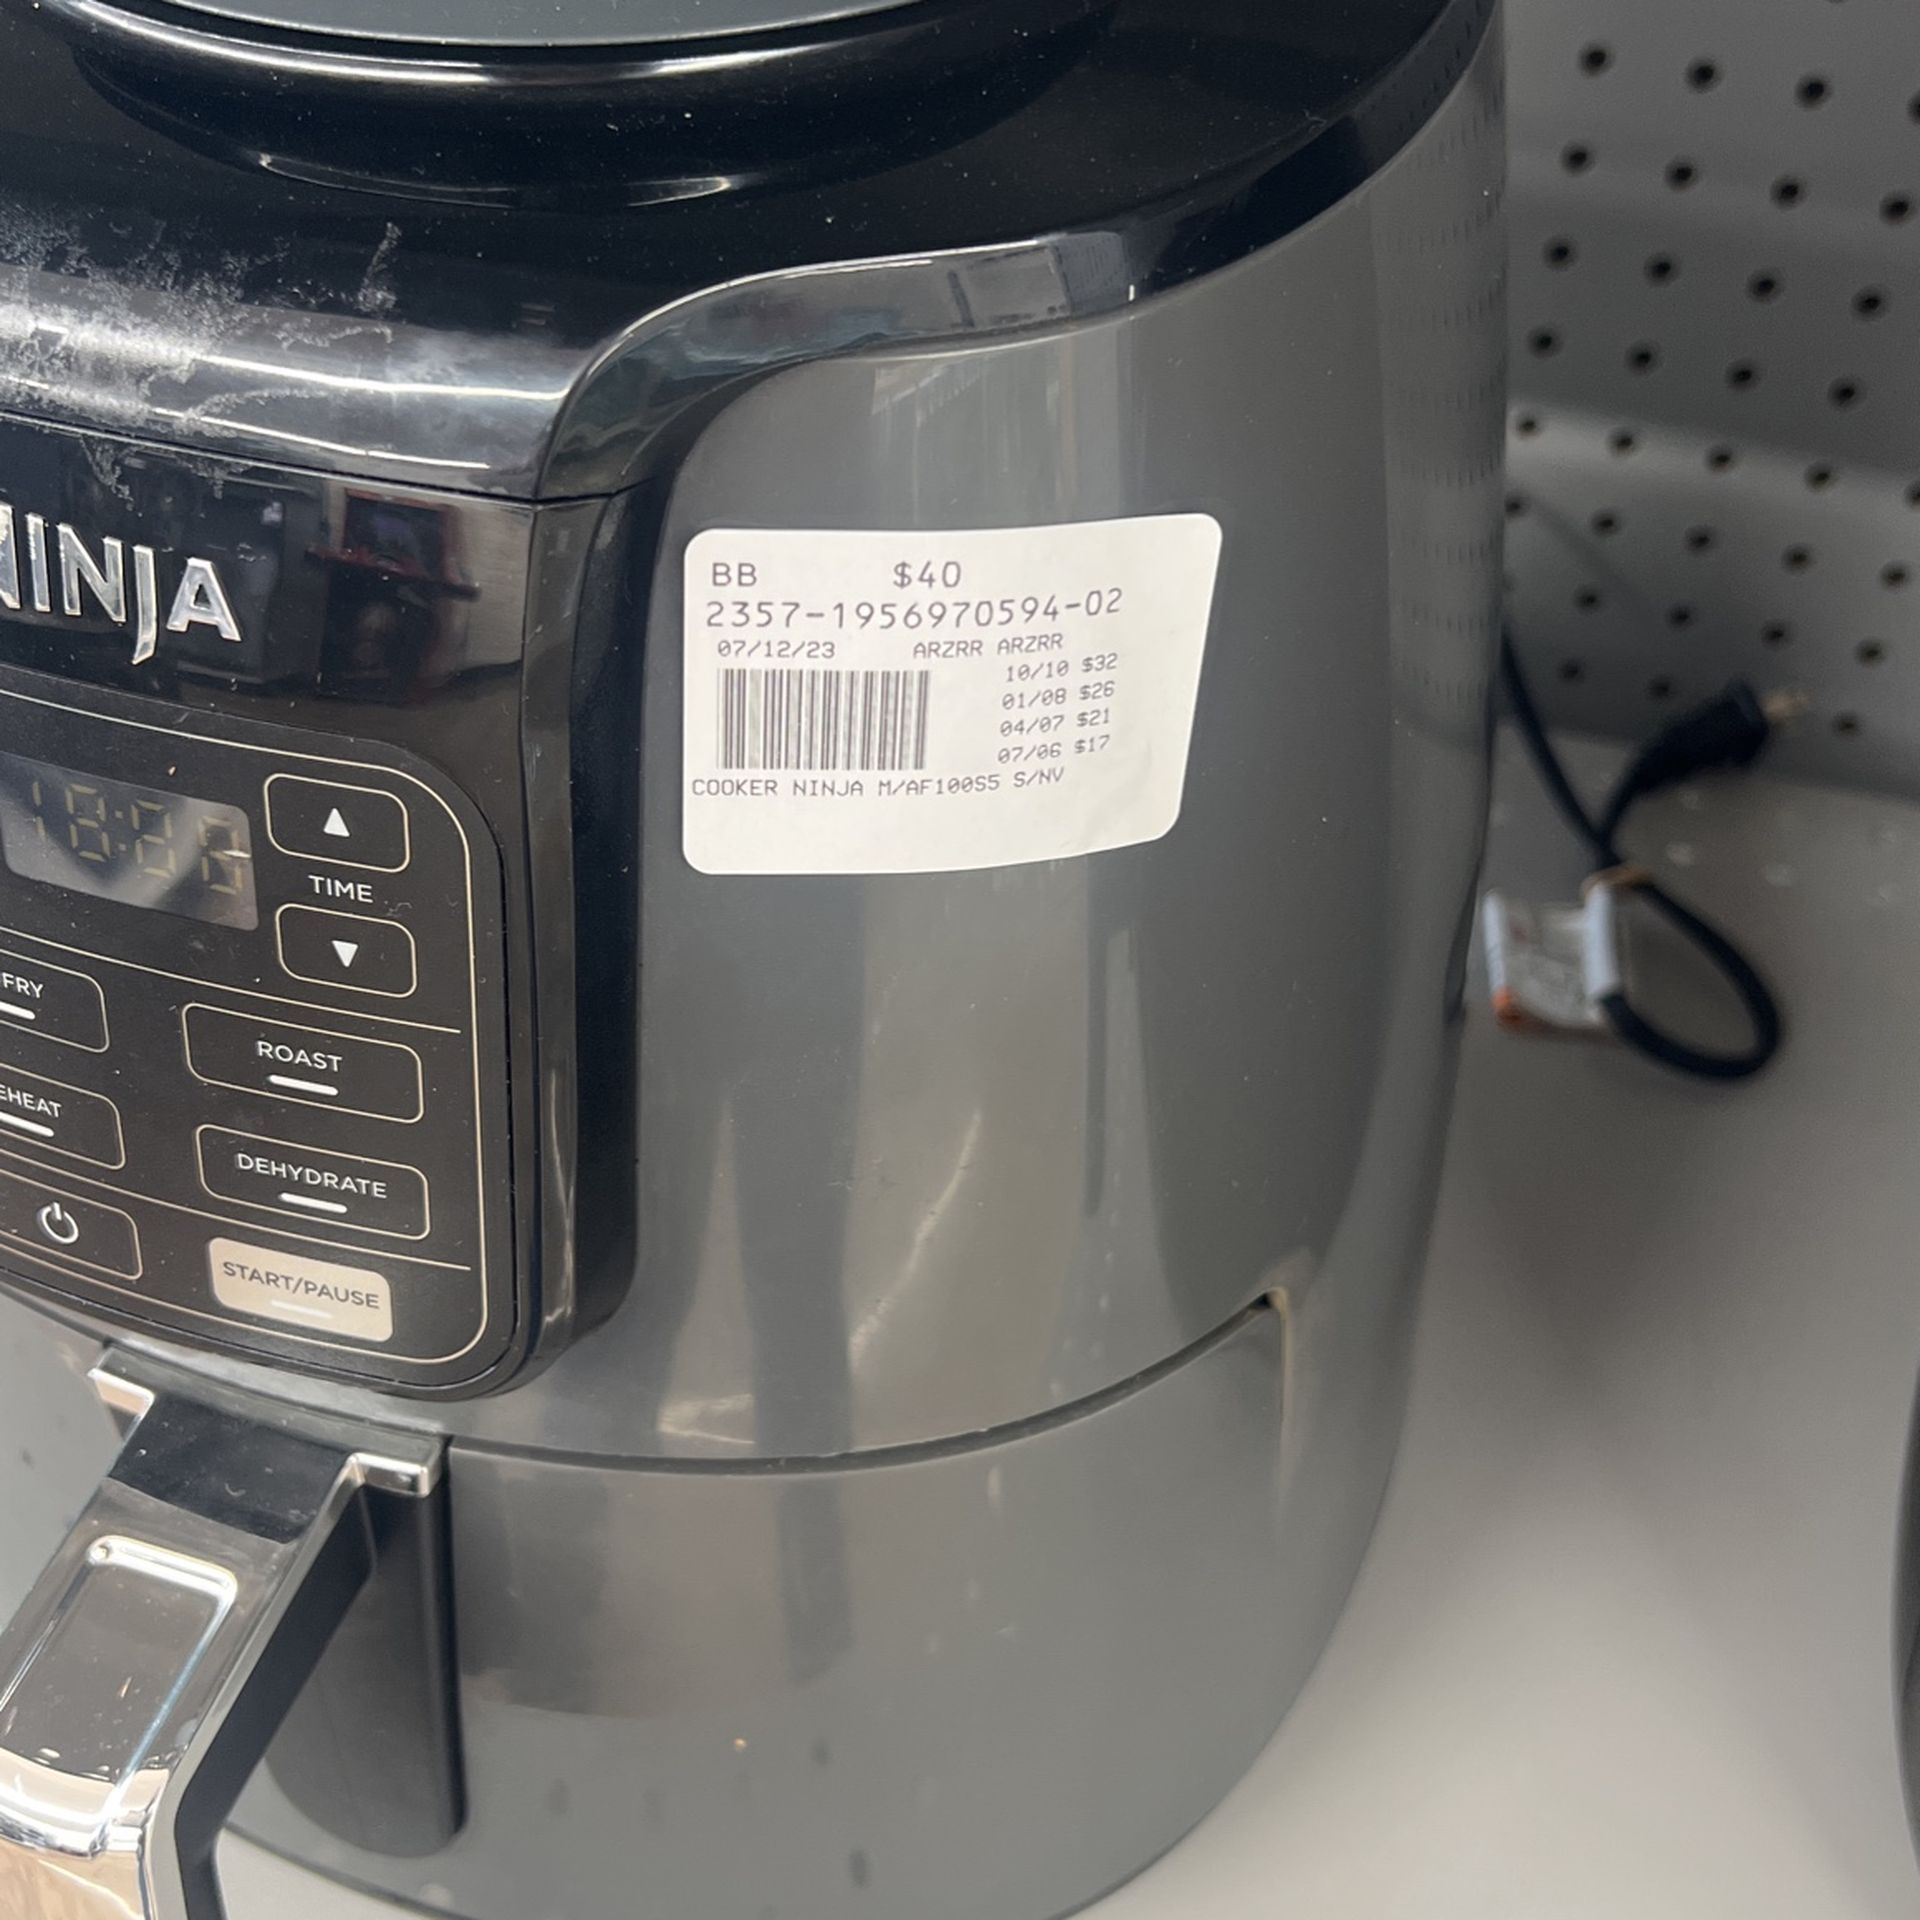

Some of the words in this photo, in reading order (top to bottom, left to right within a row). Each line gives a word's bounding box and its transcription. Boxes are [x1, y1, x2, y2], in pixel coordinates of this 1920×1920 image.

[712, 562, 758, 587] BB
[893, 560, 962, 589] $40
[706, 587, 1123, 629] 2357-1956970594-02
[717, 640, 836, 659] 07/12/23
[913, 640, 983, 659] ARZRR
[997, 633, 1063, 656] ARZRR
[1006, 660, 1069, 682] 10/10
[1081, 652, 1118, 673] $32
[1002, 687, 1067, 710] 01/08
[1079, 680, 1115, 701] $26
[1000, 714, 1065, 737] 04/07
[1076, 707, 1110, 727] $21
[998, 742, 1062, 764] 07/06
[1074, 734, 1110, 754] $17
[692, 779, 779, 796] COOKER
[793, 779, 864, 797] NINJA
[878, 773, 1001, 796] M/AF100S5
[1013, 767, 1065, 788] S/NV
[308, 874, 374, 904] TIME
[2, 971, 44, 999] FRY
[256, 1040, 343, 1073] ROAST
[235, 1152, 387, 1199] DEHYDRATE
[222, 1260, 380, 1310] START/PAUSE
